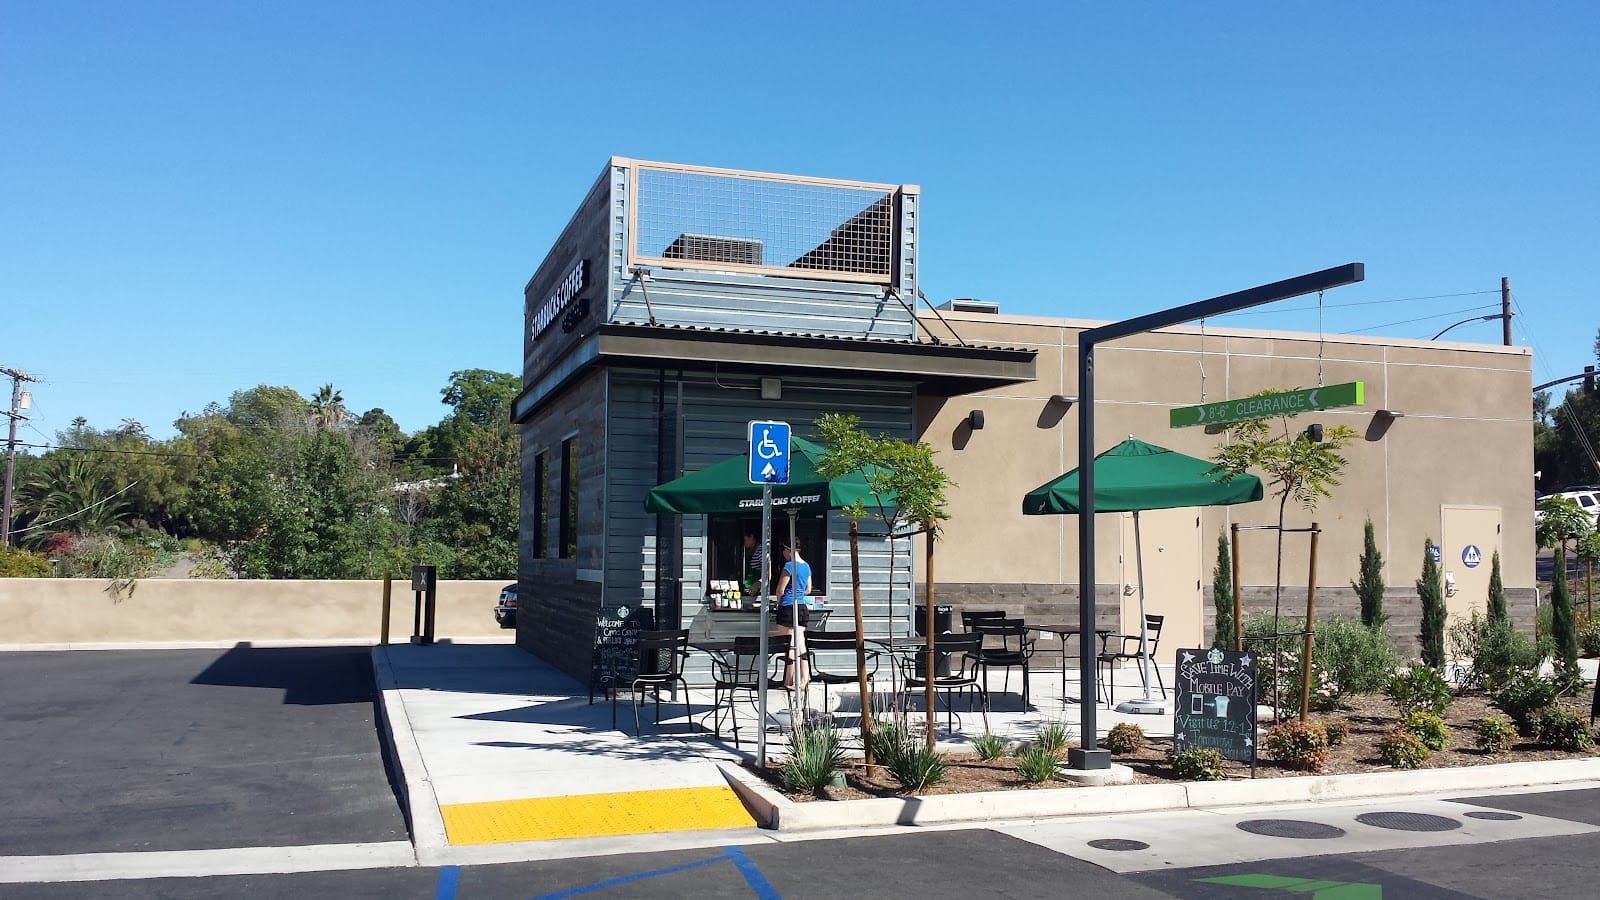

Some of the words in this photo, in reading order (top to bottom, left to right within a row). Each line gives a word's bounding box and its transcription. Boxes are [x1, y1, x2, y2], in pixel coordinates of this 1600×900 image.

[531, 287, 560, 342] STARBUCKS
[560, 259, 584, 310] COFFEE
[1236, 394, 1305, 416] CLEARANCE
[738, 497, 789, 508] STARCKS
[790, 495, 821, 504] COFFEE
[1180, 660, 1208, 680] SAVE
[1206, 660, 1229, 675] TIME
[1229, 662, 1255, 690] WITH
[1187, 677, 1223, 696] MOBILE
[1226, 681, 1247, 698] PAY
